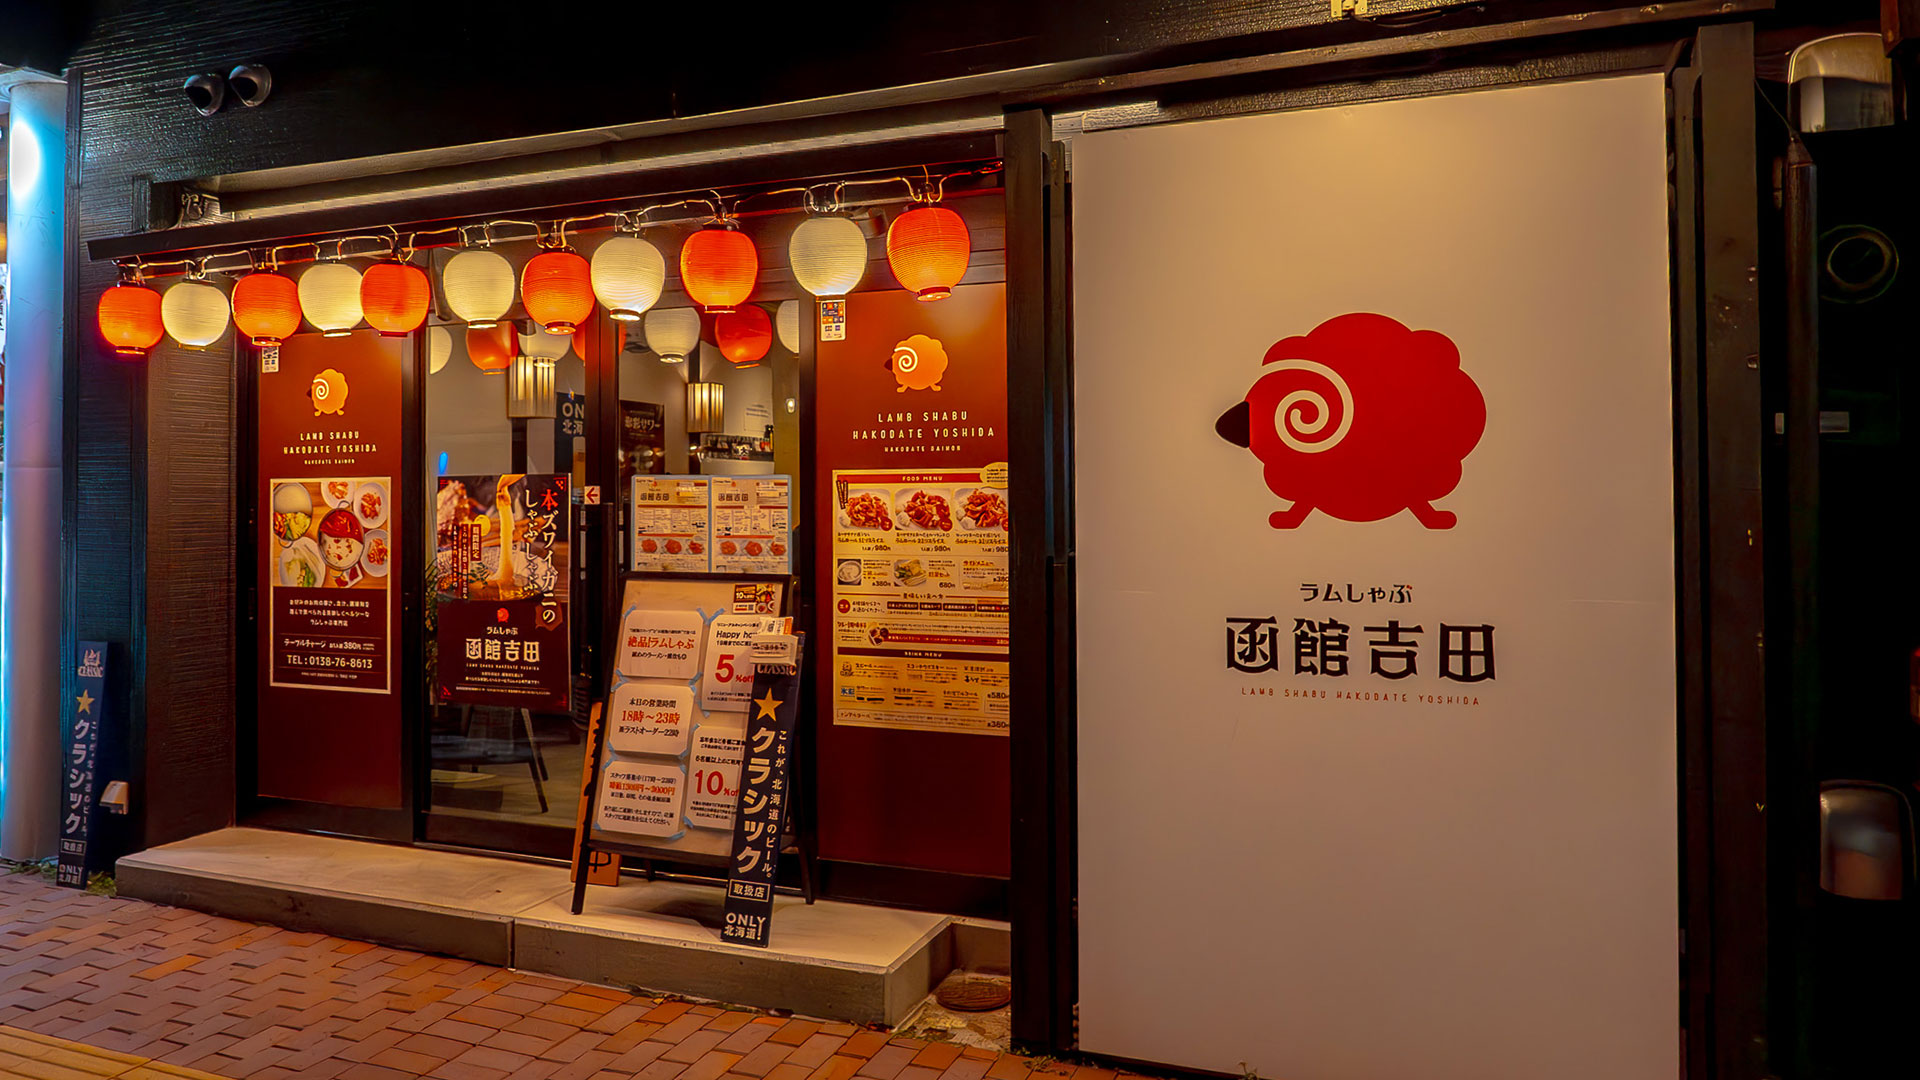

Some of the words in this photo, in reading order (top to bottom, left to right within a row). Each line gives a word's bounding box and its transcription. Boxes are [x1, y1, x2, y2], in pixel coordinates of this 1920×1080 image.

[878, 412, 912, 423] LAMB
[923, 410, 968, 421] SHABU
[300, 432, 323, 441] LAMB
[330, 431, 360, 440] SHABU
[852, 428, 923, 440] HAKODATE
[933, 427, 995, 437] YOSHIDA
[283, 445, 330, 454] HAKODATE
[337, 444, 377, 453] YOSHIDA
[523, 489, 538, 591] しゃぶしゃぶ
[540, 488, 559, 623] 本ズワイガニの
[1300, 583, 1413, 604] ラムしゃぶ
[486, 626, 518, 635] ラムしゃぶ
[716, 630, 740, 639] Happy
[465, 638, 540, 662] 函館吉田
[1225, 616, 1496, 683] 函館吉田
[629, 697, 677, 709] 本日の営業時間
[1241, 687, 1274, 696] LAMB
[1284, 688, 1326, 699] SHABU
[1336, 690, 1408, 702] HAKODATE
[1418, 695, 1480, 706] YOSHIDA
[65, 719, 90, 834] クラシック
[736, 727, 776, 874] クラシック
[762, 730, 787, 878] これが、北海道のビール。
[733, 883, 765, 898] 取扱店
